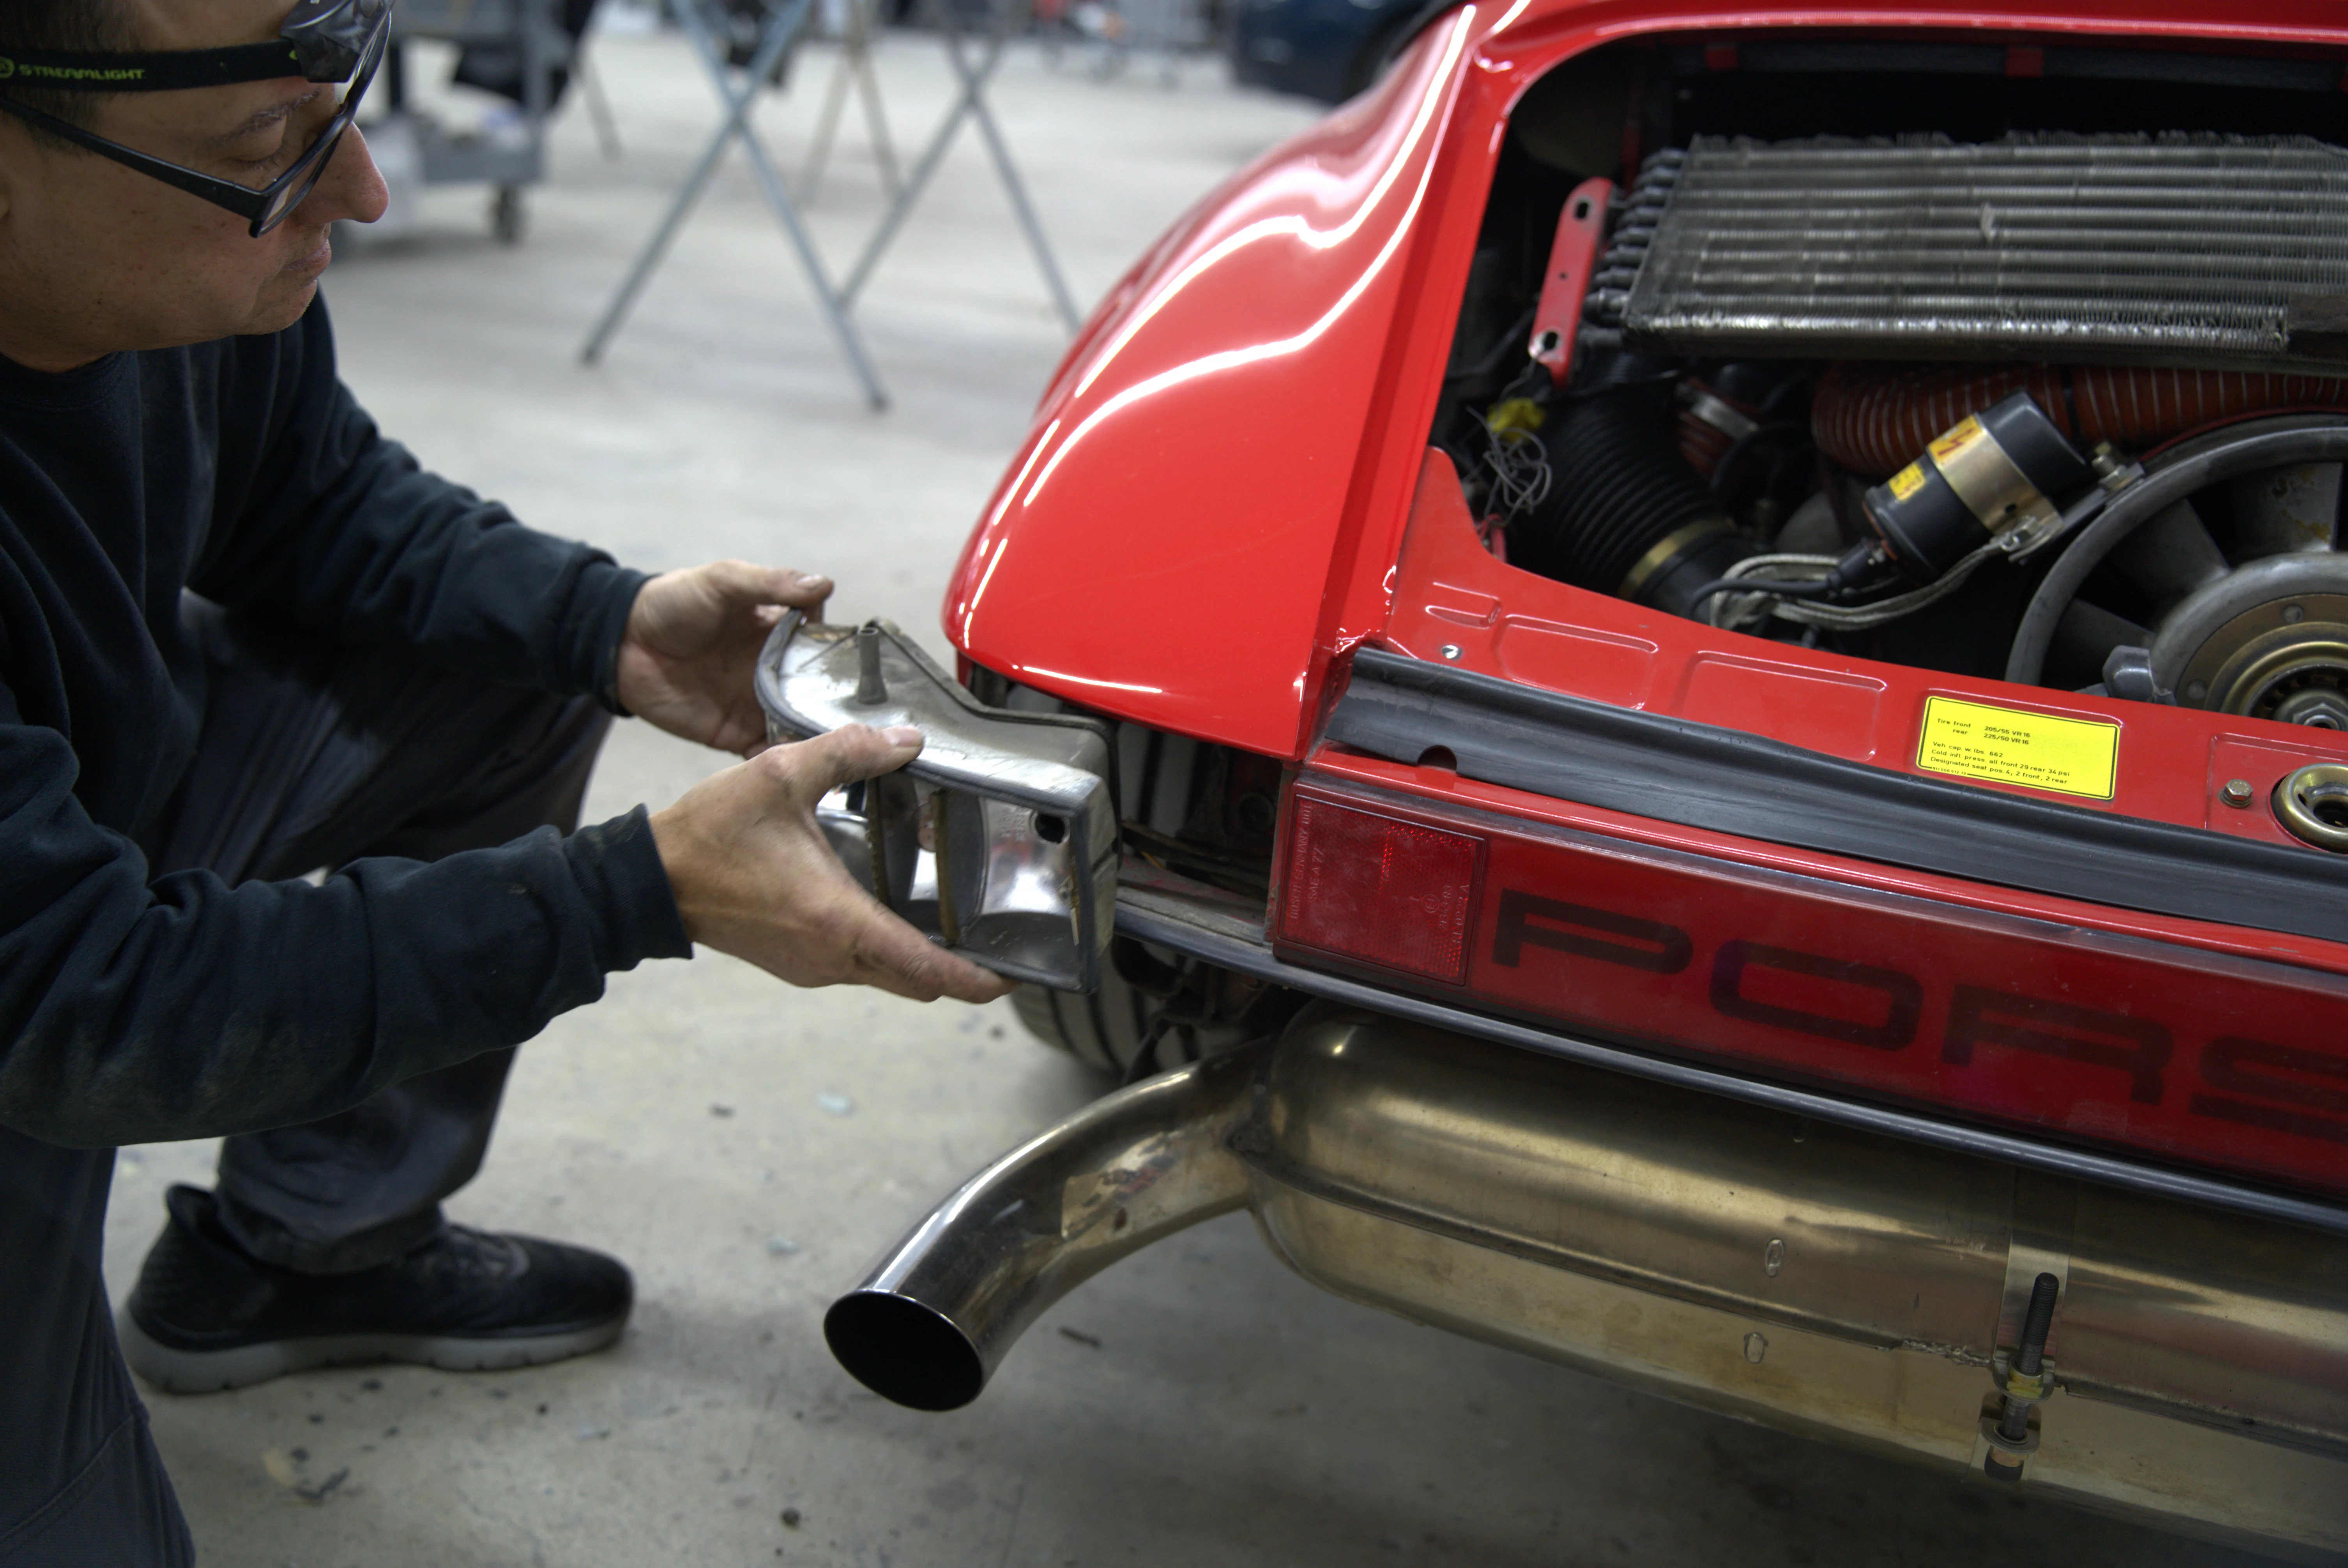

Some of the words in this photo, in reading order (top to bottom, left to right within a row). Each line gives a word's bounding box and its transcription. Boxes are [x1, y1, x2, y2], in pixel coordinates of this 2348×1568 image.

[18, 64, 145, 80] STREAMLIGHT
[1984, 726, 2010, 734] 205/55
[1984, 733, 2009, 741] 225/50
[1931, 756, 1969, 767] Designated
[2023, 772, 2042, 781] front,
[1293, 828, 1308, 880] GERMANY
[1311, 866, 1321, 875] A
[1308, 877, 1319, 900] SAE
[1289, 885, 1301, 919] BOSCH
